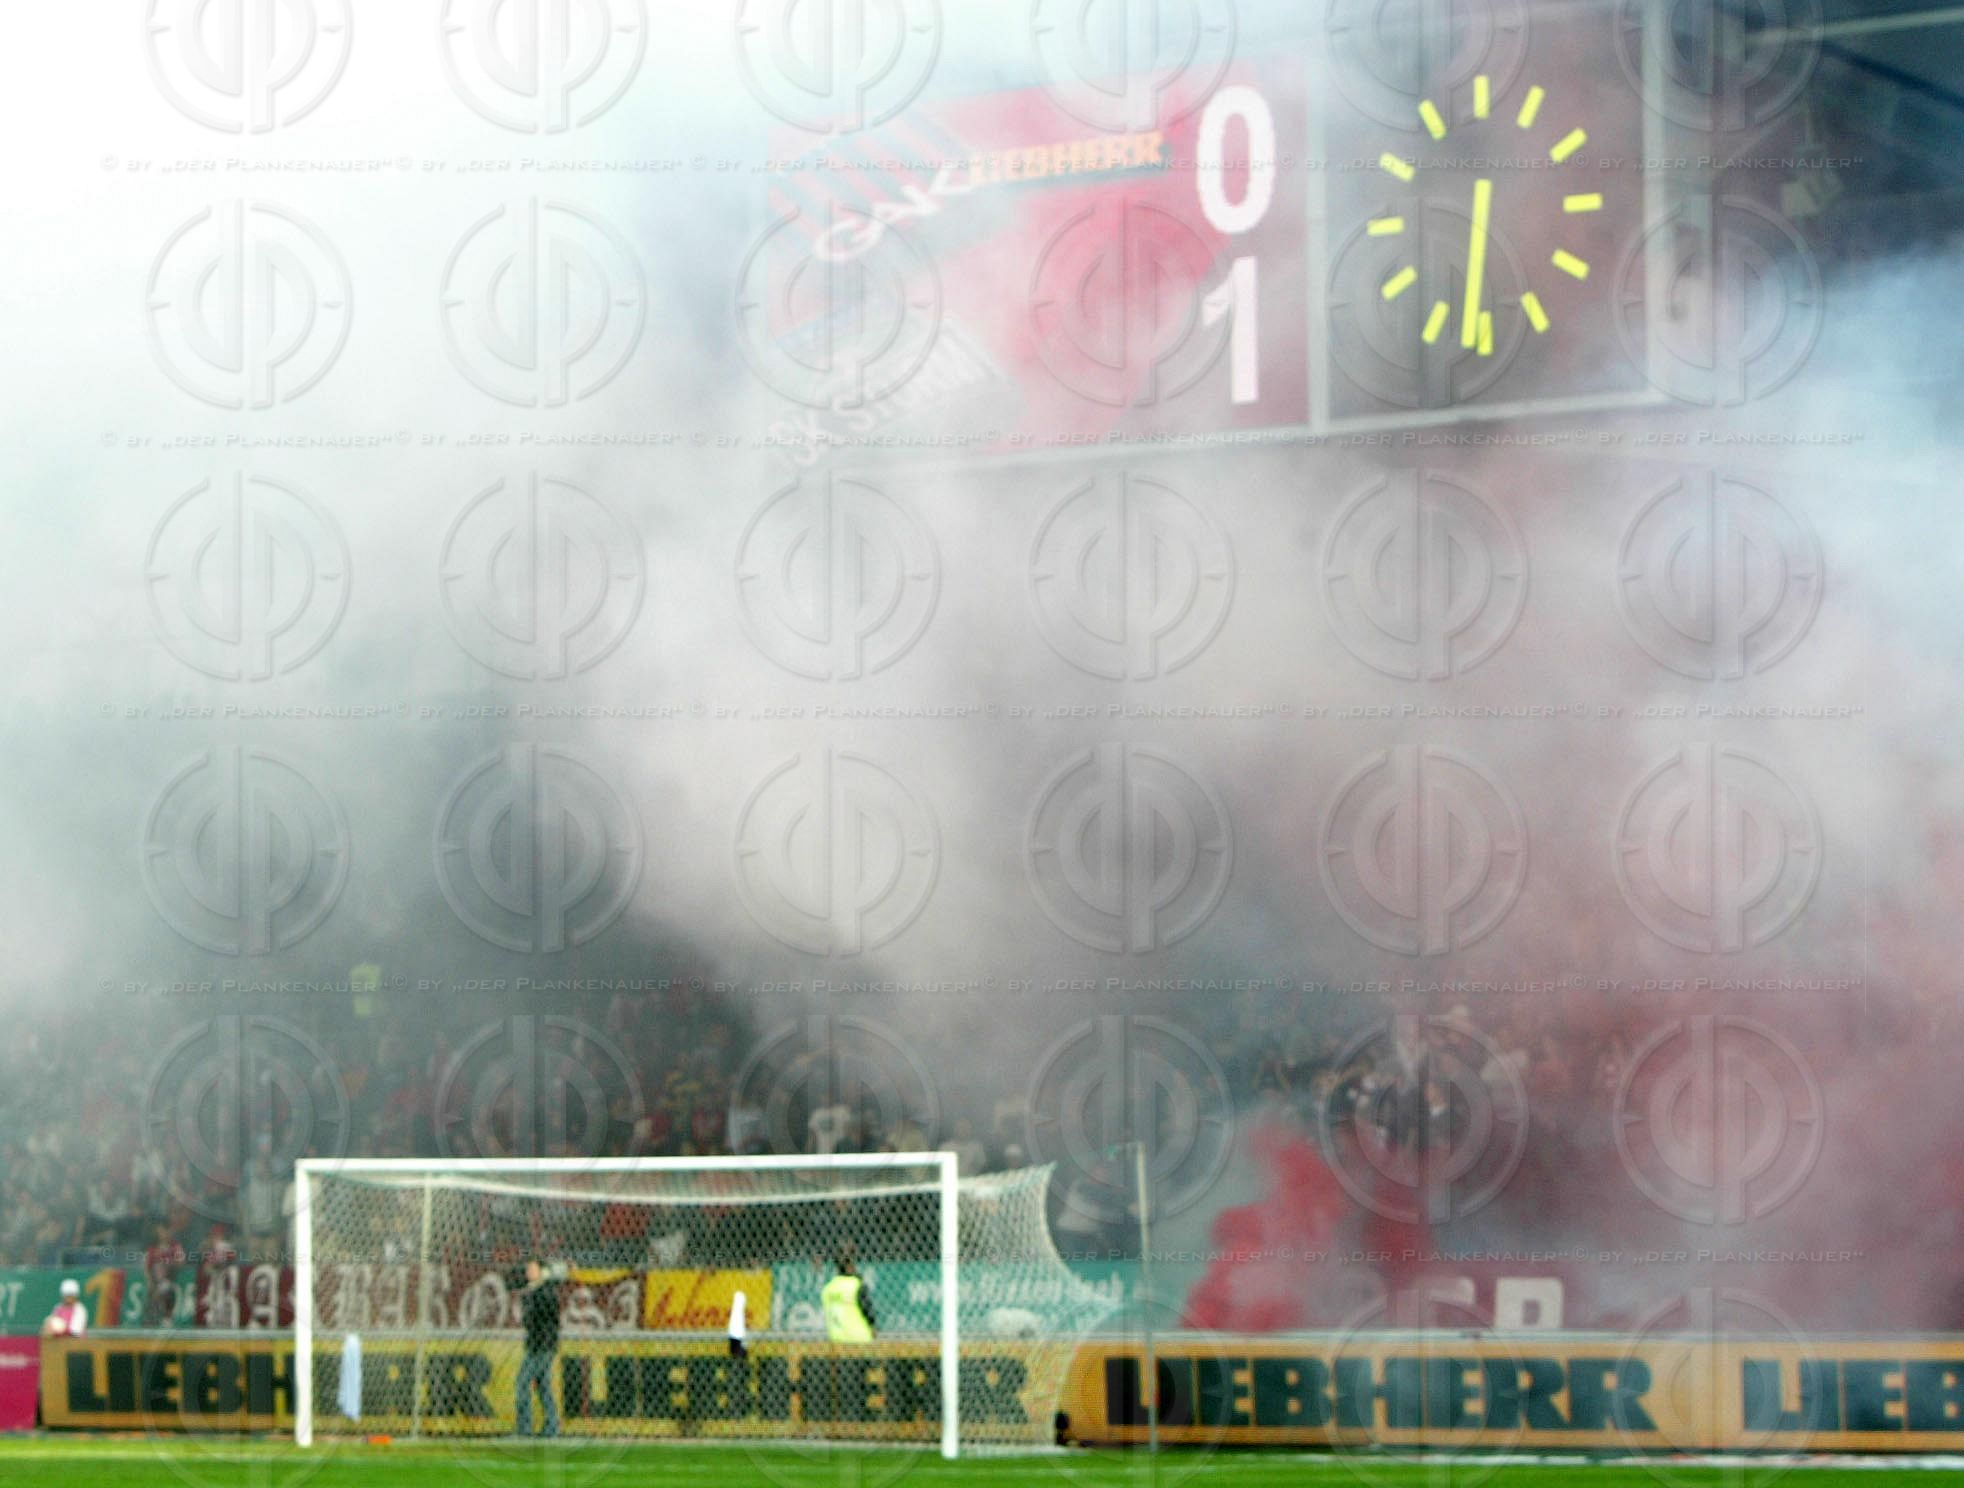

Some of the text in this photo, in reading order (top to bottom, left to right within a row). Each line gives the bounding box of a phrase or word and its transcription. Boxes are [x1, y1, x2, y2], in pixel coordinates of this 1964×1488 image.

[1198, 85, 1275, 233] 0
[1203, 256, 1258, 403] 1
[1105, 1356, 1659, 1431] LIEBHERR
